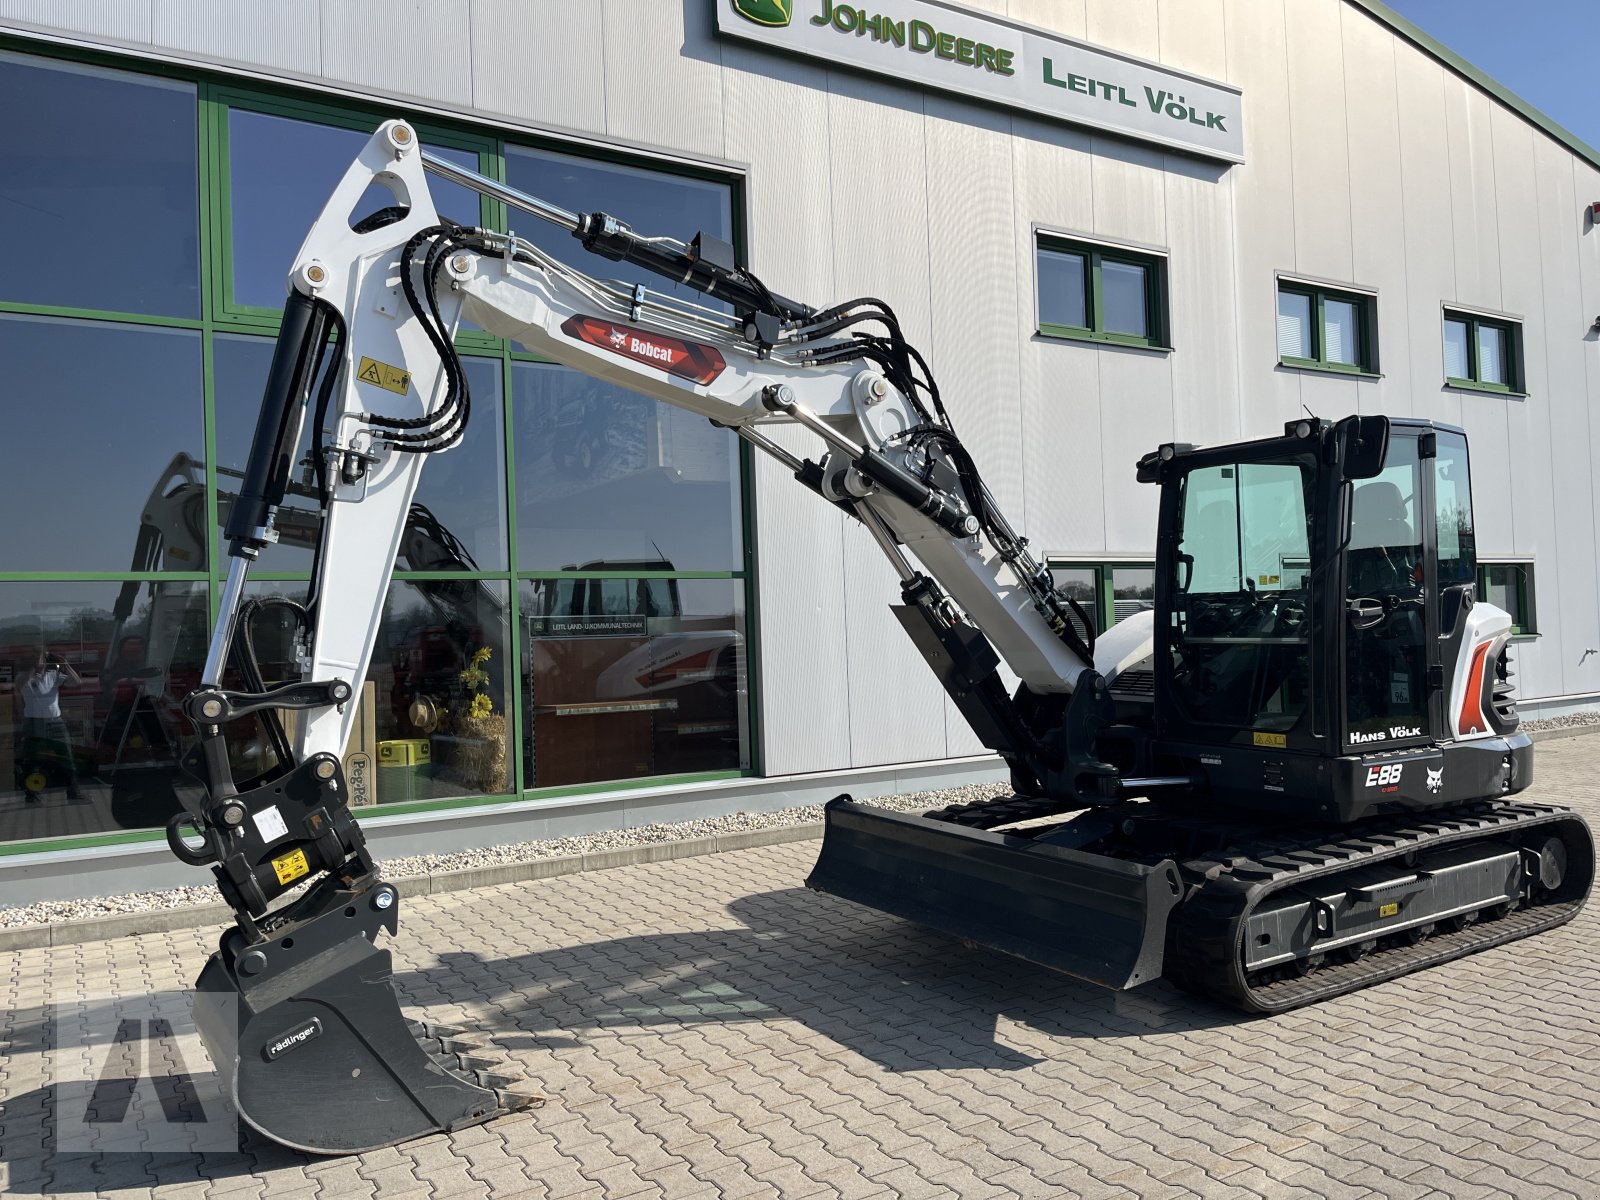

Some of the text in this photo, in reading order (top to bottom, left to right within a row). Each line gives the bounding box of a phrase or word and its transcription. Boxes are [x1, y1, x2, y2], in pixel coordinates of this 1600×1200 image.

[810, 0, 1015, 76] JOHN DEERE
[1042, 56, 1228, 132] LEITL VÖLK
[630, 337, 672, 363] Bobcat
[1349, 725, 1422, 744] HANS VÖLK
[1364, 763, 1403, 787] E88
[270, 1026, 315, 1054] rädlinger
